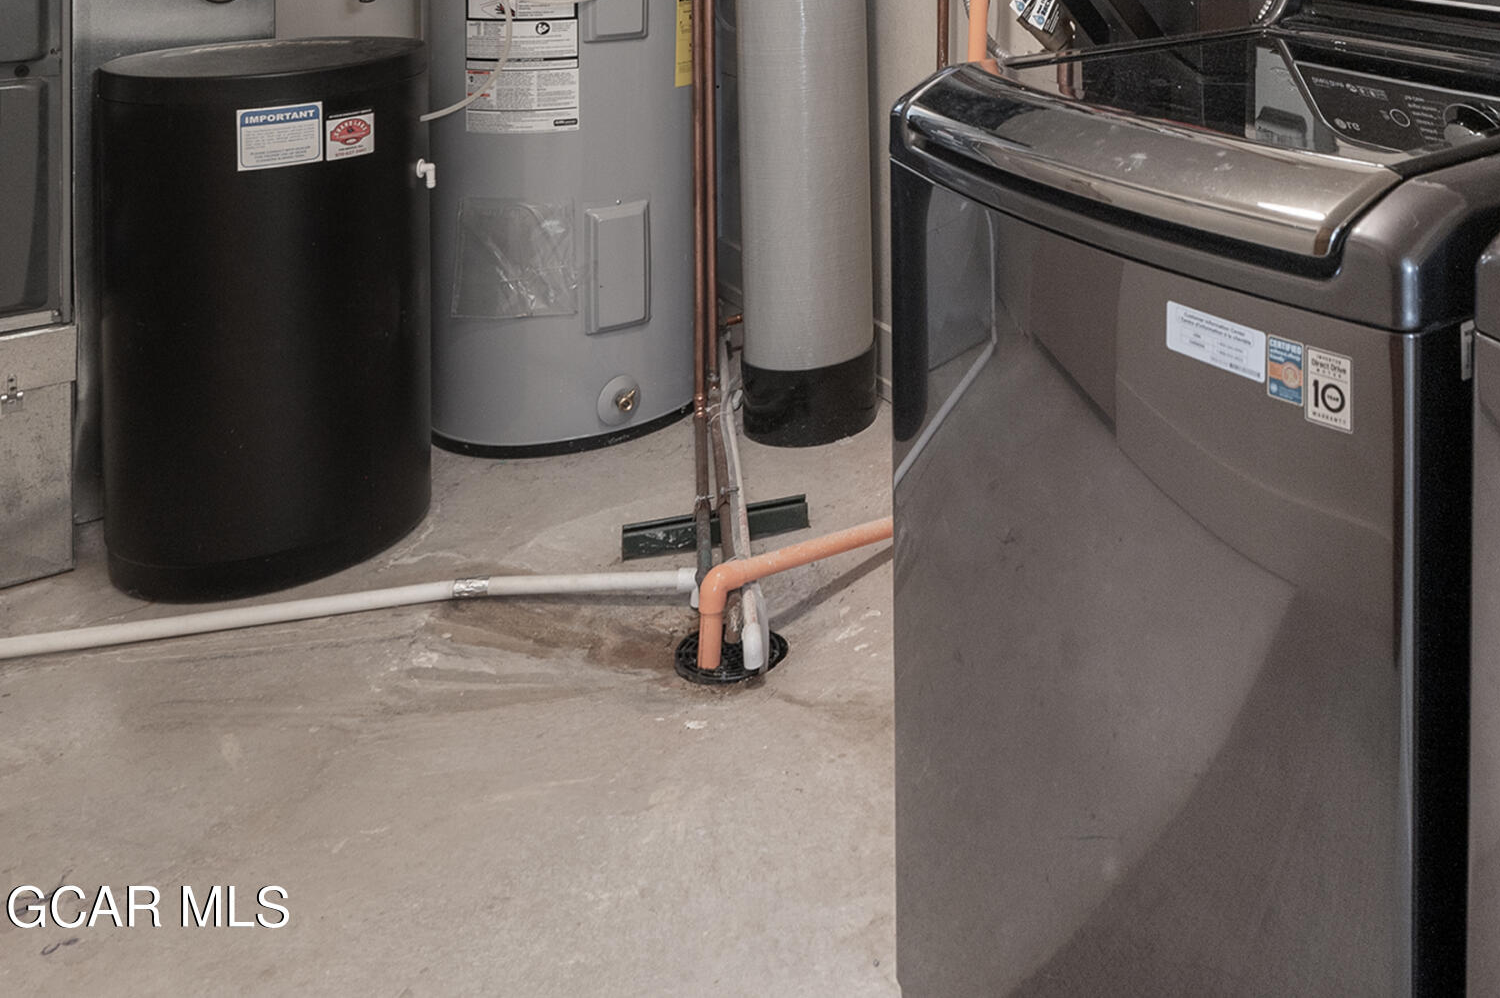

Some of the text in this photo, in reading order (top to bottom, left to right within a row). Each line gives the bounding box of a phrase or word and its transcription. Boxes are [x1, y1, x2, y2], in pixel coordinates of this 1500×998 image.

[244, 109, 316, 125] IMPORTANT
[1311, 358, 1347, 375] Direct Drive
[1312, 379, 1346, 414] 10
